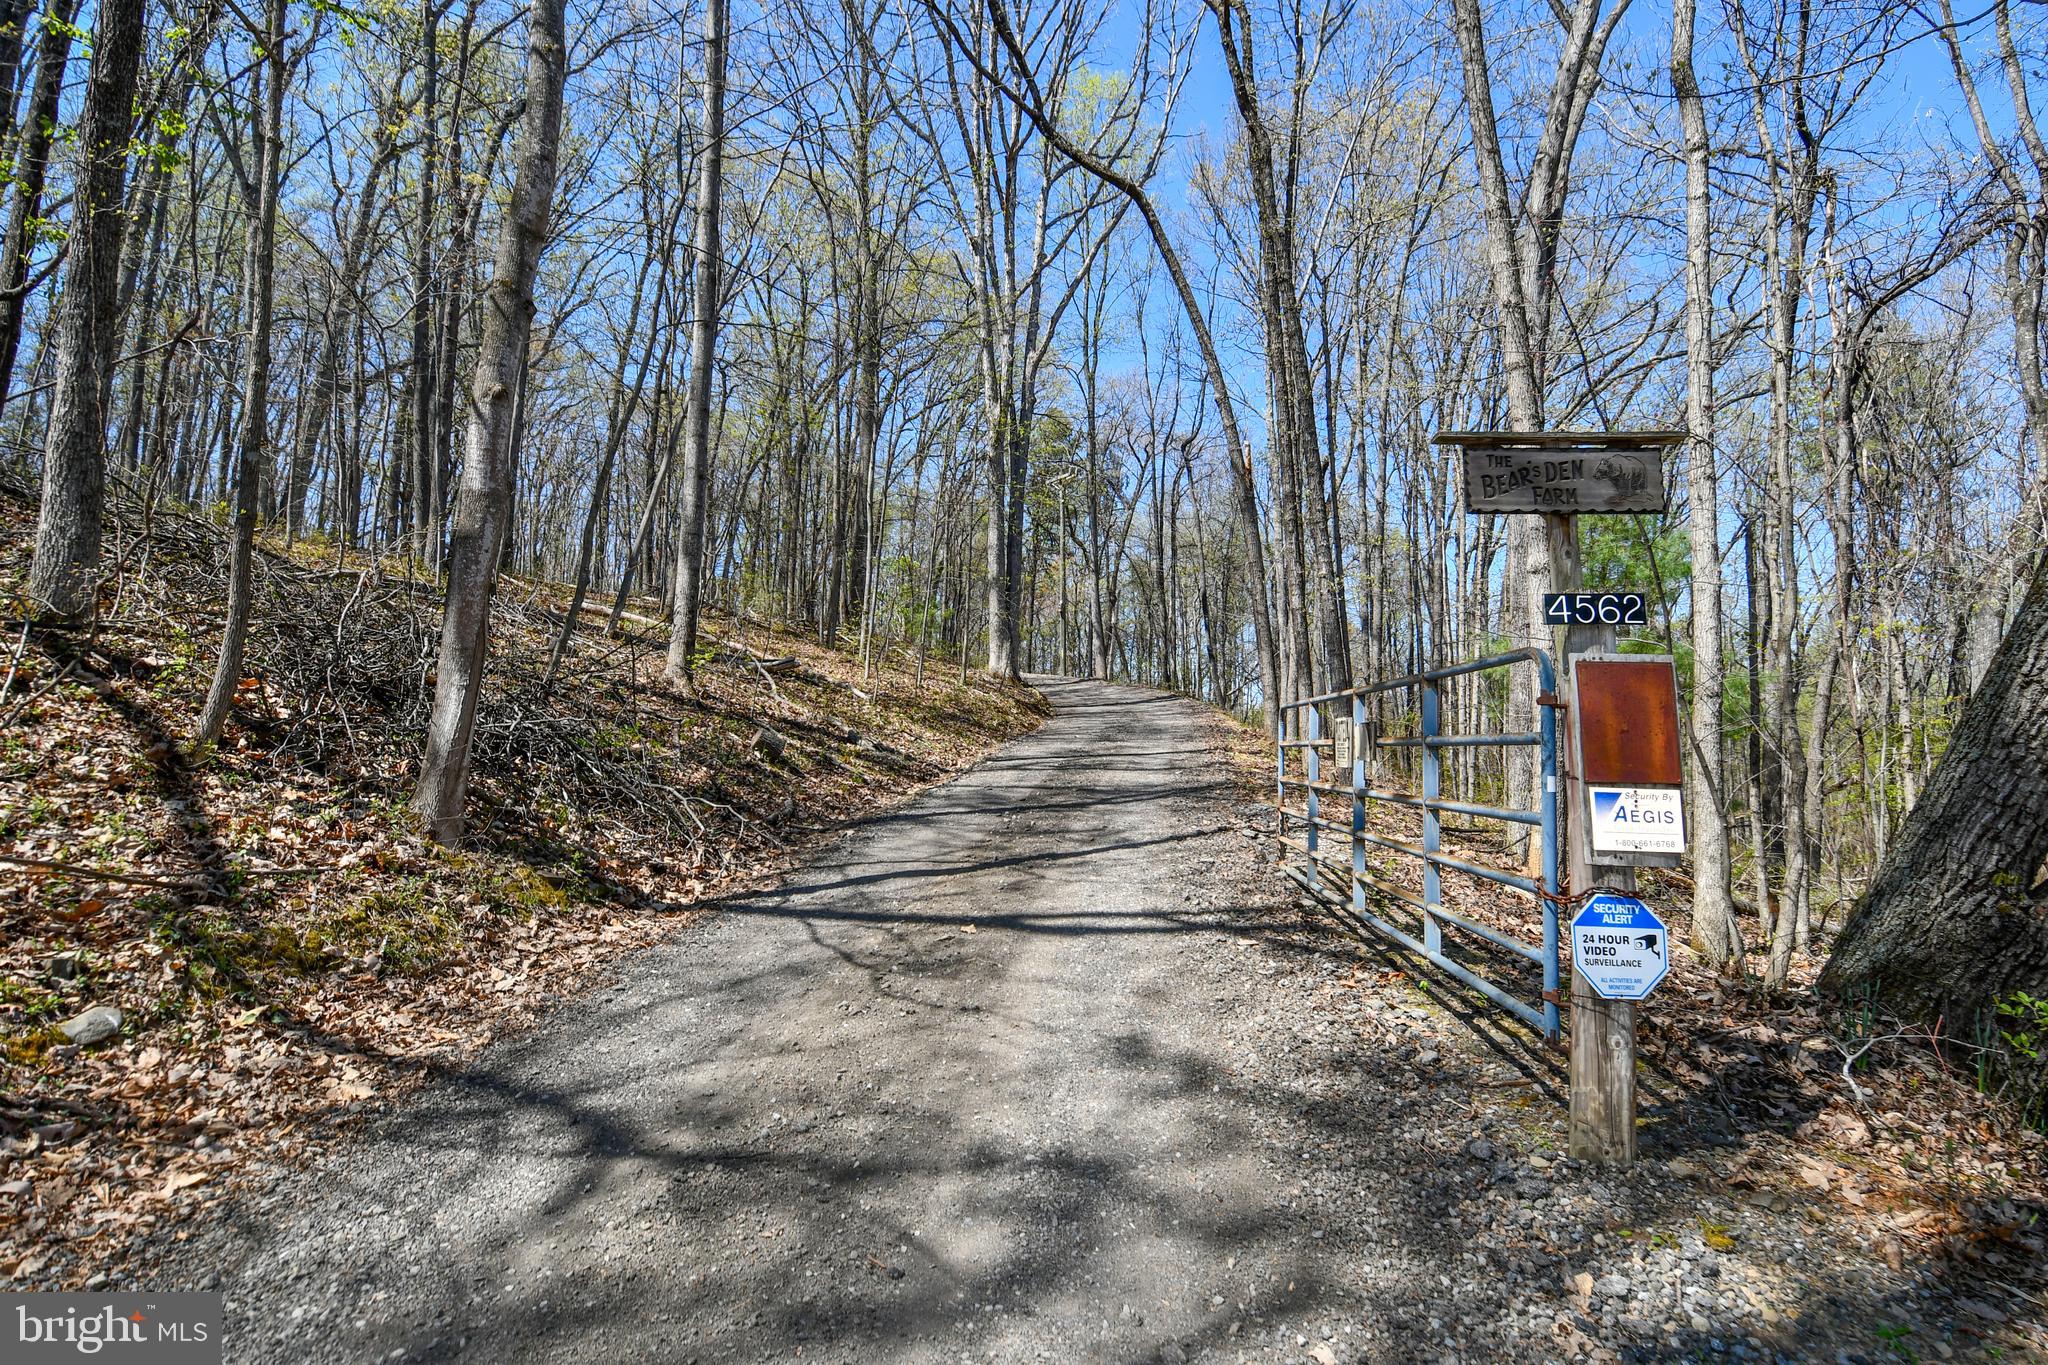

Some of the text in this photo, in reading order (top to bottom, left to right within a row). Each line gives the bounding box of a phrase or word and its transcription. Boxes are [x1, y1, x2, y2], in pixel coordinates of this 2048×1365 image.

[1486, 454, 1513, 468] THE
[1544, 459, 1584, 483] DEN
[1532, 486, 1579, 505] FARM
[1548, 595, 1644, 624] 4562
[1624, 791, 1674, 802] Security By
[1593, 903, 1640, 914] SECURITY
[1602, 914, 1633, 924] ALERT
[1582, 934, 1630, 945] 24 HOUR
[1583, 946, 1617, 957] VIDEO
[1584, 958, 1643, 968] SURVEILLANCE
